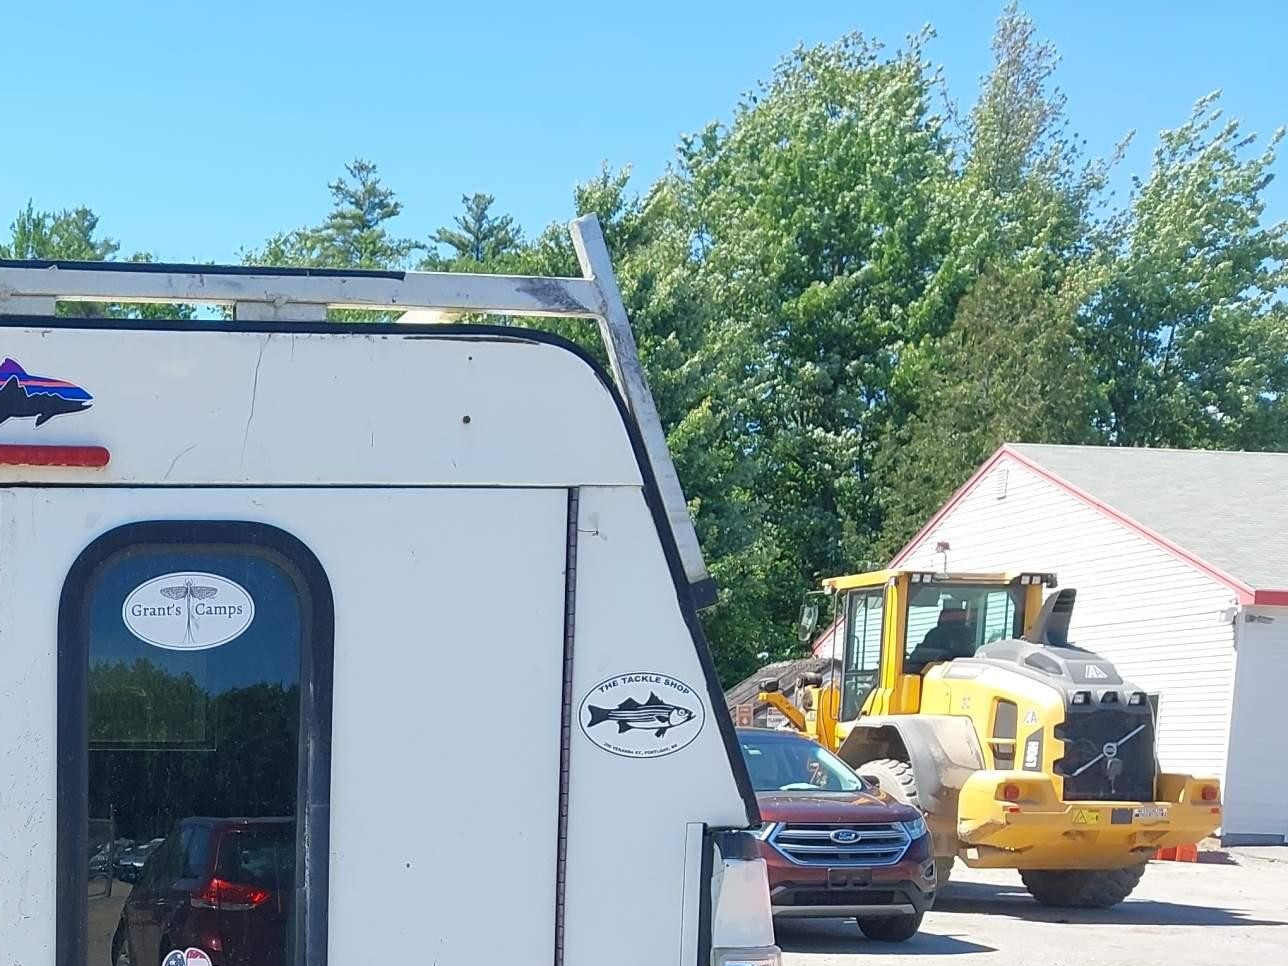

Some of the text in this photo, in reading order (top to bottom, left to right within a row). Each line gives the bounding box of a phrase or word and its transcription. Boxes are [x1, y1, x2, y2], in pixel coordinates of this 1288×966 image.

[131, 603, 243, 618] Grant's Camps
[598, 675, 690, 695] THE TACKLE SHOP
